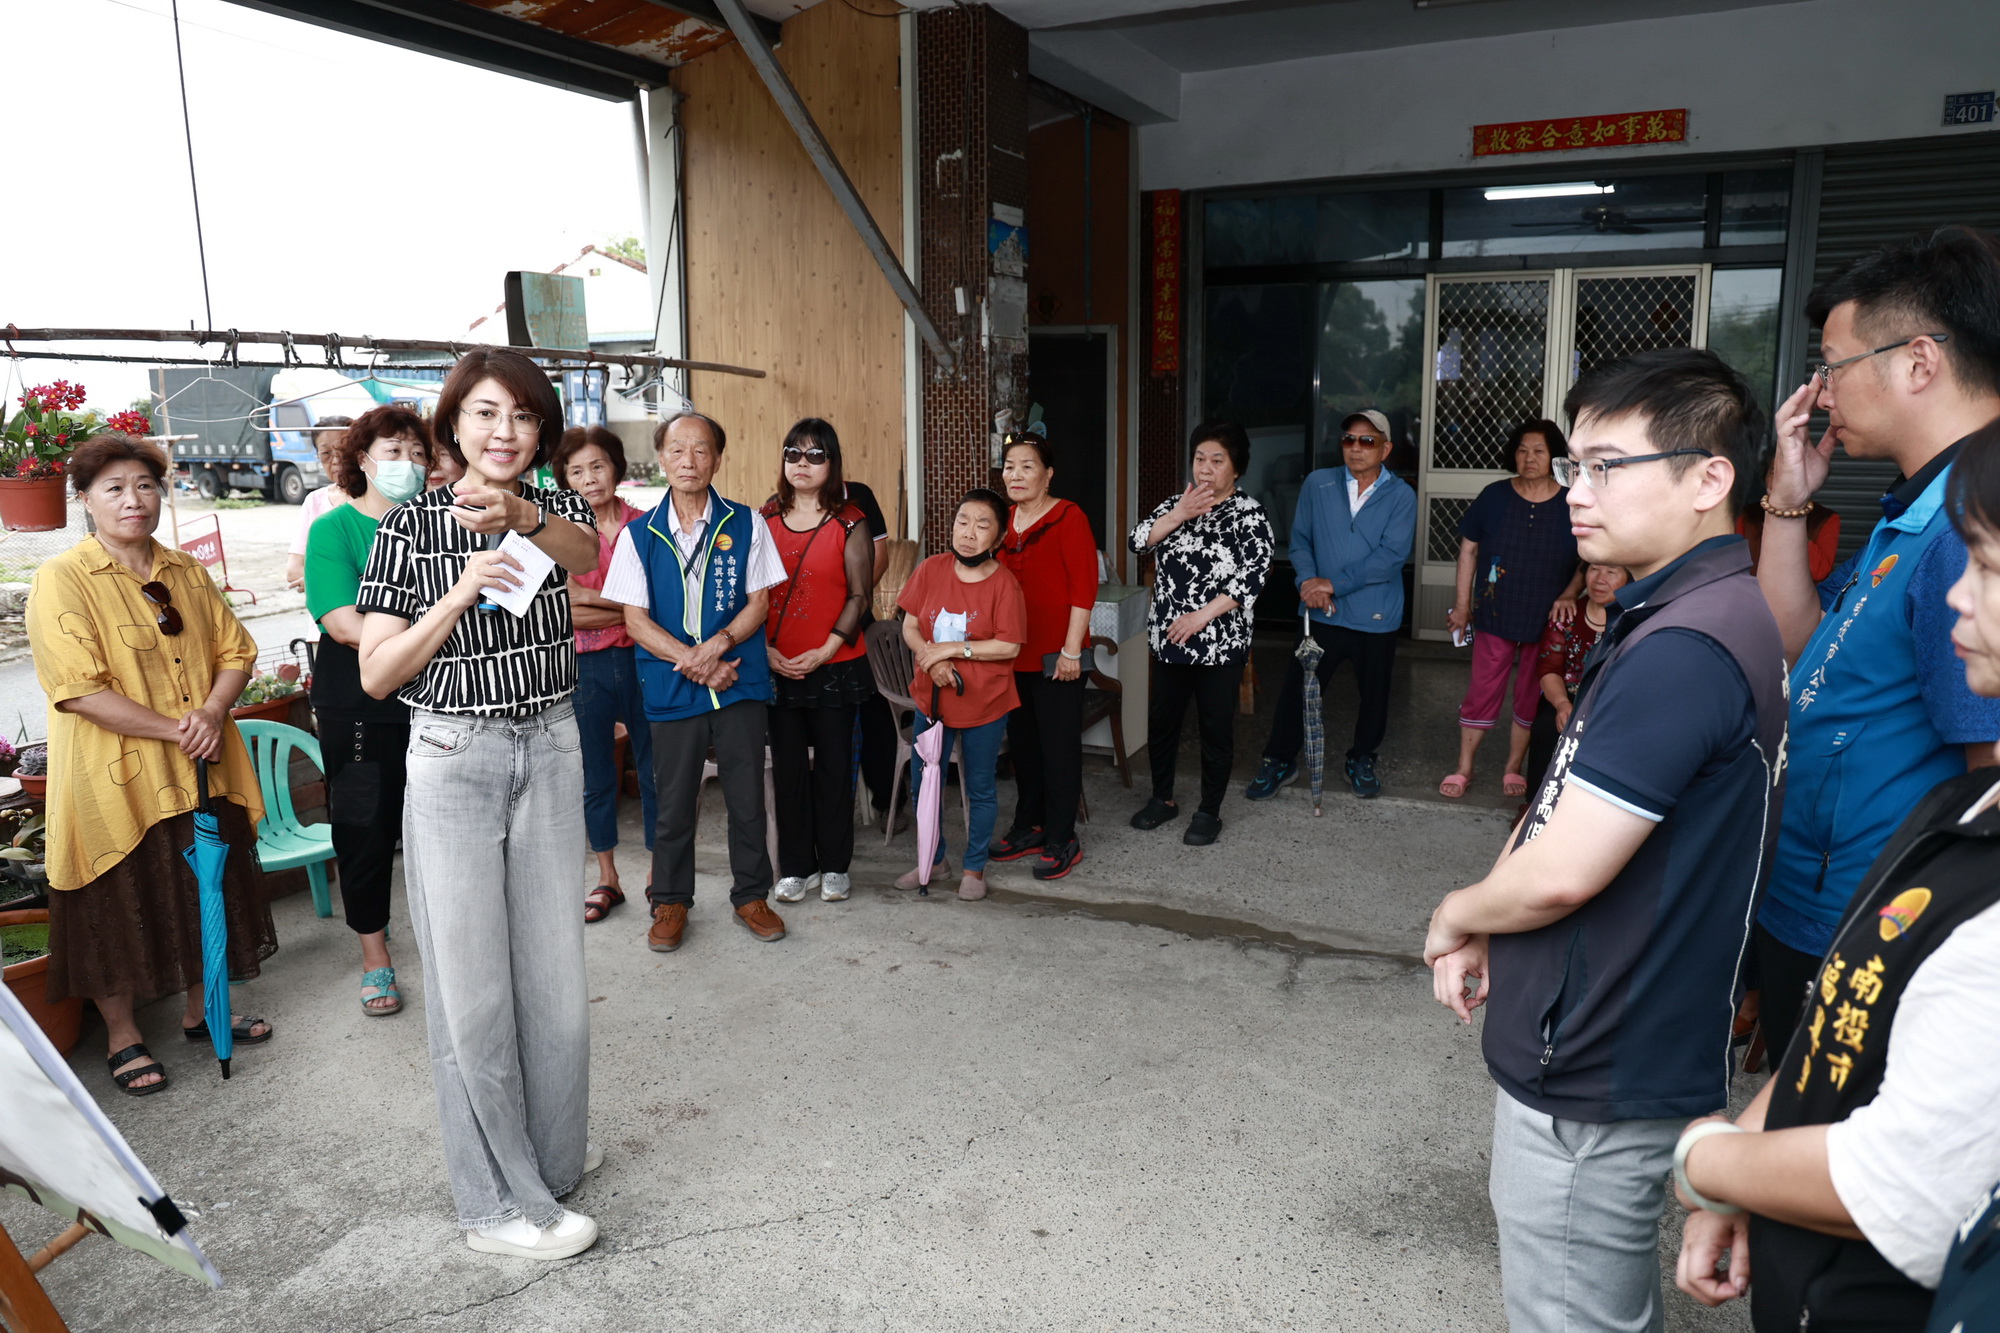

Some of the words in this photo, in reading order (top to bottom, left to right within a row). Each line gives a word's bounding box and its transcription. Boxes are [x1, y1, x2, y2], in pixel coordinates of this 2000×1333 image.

[1956, 104, 1987, 122] 401
[727, 555, 737, 610] 南投市公所
[1796, 594, 1868, 712] 南投市公所
